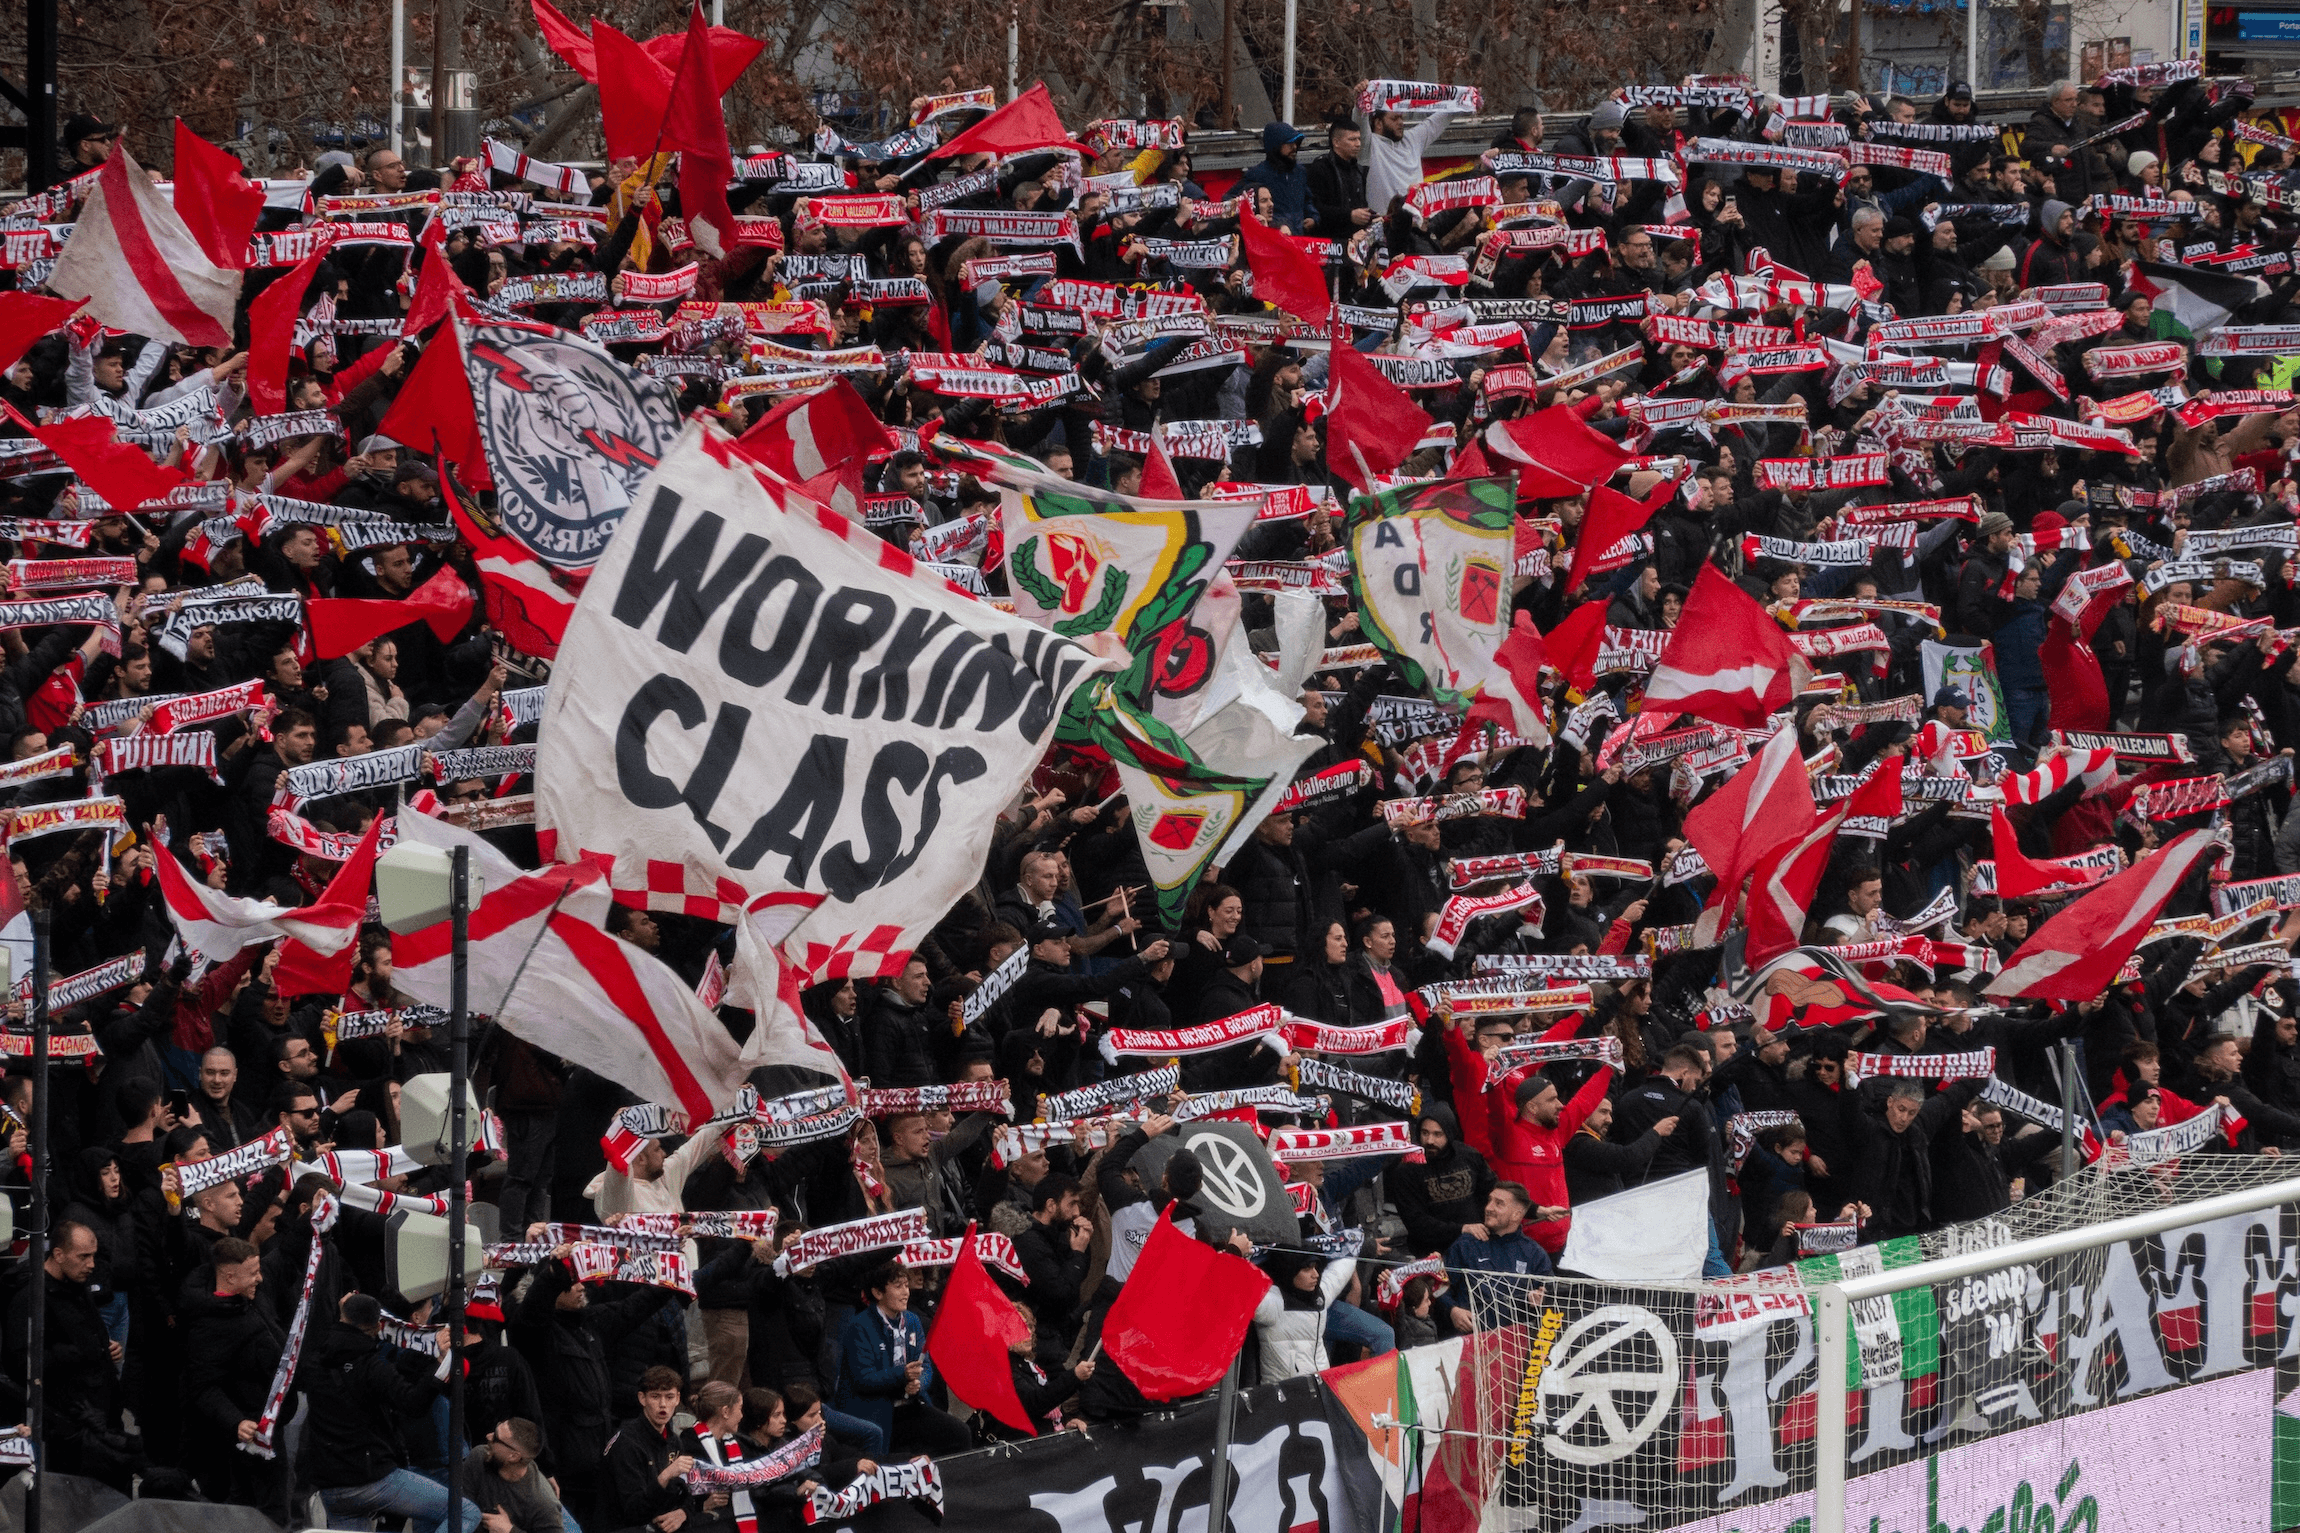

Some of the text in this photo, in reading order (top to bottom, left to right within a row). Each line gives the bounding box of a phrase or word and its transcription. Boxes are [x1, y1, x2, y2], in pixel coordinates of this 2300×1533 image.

[1400, 84, 1458, 101] VALLECANO
[1763, 151, 1846, 181] VALLECAO
[1424, 177, 1491, 204] RAYO VALLECANO
[2208, 172, 2244, 197] RAYO
[2111, 194, 2197, 214] VALLECANO
[945, 218, 1059, 236] RAYO VALLECANO
[6, 234, 46, 264] VETE
[274, 231, 314, 263] VETE
[2183, 240, 2289, 273] RAYO VALLECANO
[1054, 281, 1197, 318] PRESA VETE
[1021, 308, 1082, 330] Rayo Vallecano
[1582, 300, 1645, 323] VALLECANO
[1453, 324, 1522, 345] RAYO VALLECANO
[1656, 317, 1773, 348] PRESA VETE
[1882, 320, 1983, 339] RAYO VALLECANO
[1747, 350, 1799, 368] VALLECANO
[1484, 375, 1503, 392] RAYO
[1855, 363, 1944, 384] RAYO VALLECANO
[1953, 403, 1980, 420] RAYO
[1903, 426, 1930, 442] Mi
[2027, 416, 2054, 433] RAYO
[1766, 455, 1885, 486] PRESA VETE YA
[1273, 492, 1290, 505] 1924
[1248, 565, 1313, 586] VALLECANO
[1838, 625, 1886, 647] VALLECANO
[1638, 730, 1714, 759] RAYO VALLECANO
[1968, 732, 1986, 751] 10
[2068, 732, 2169, 756] RAYO VALLECANO
[616, 673, 988, 904] CLASS
[1294, 769, 1354, 798] Vallecano
[1344, 783, 1359, 798] 1924
[1675, 851, 1704, 876] Rayo
[2225, 884, 2287, 913] WORKING
[1475, 954, 1618, 971] MALDITOS
[1163, 1026, 1177, 1047] la
[1178, 1020, 1225, 1046] victoria
[1225, 1007, 1272, 1035] siempre
[1281, 1141, 1401, 1158] BELLA COMO UN GOL EN EL
[1946, 1264, 2027, 1323] siemp
